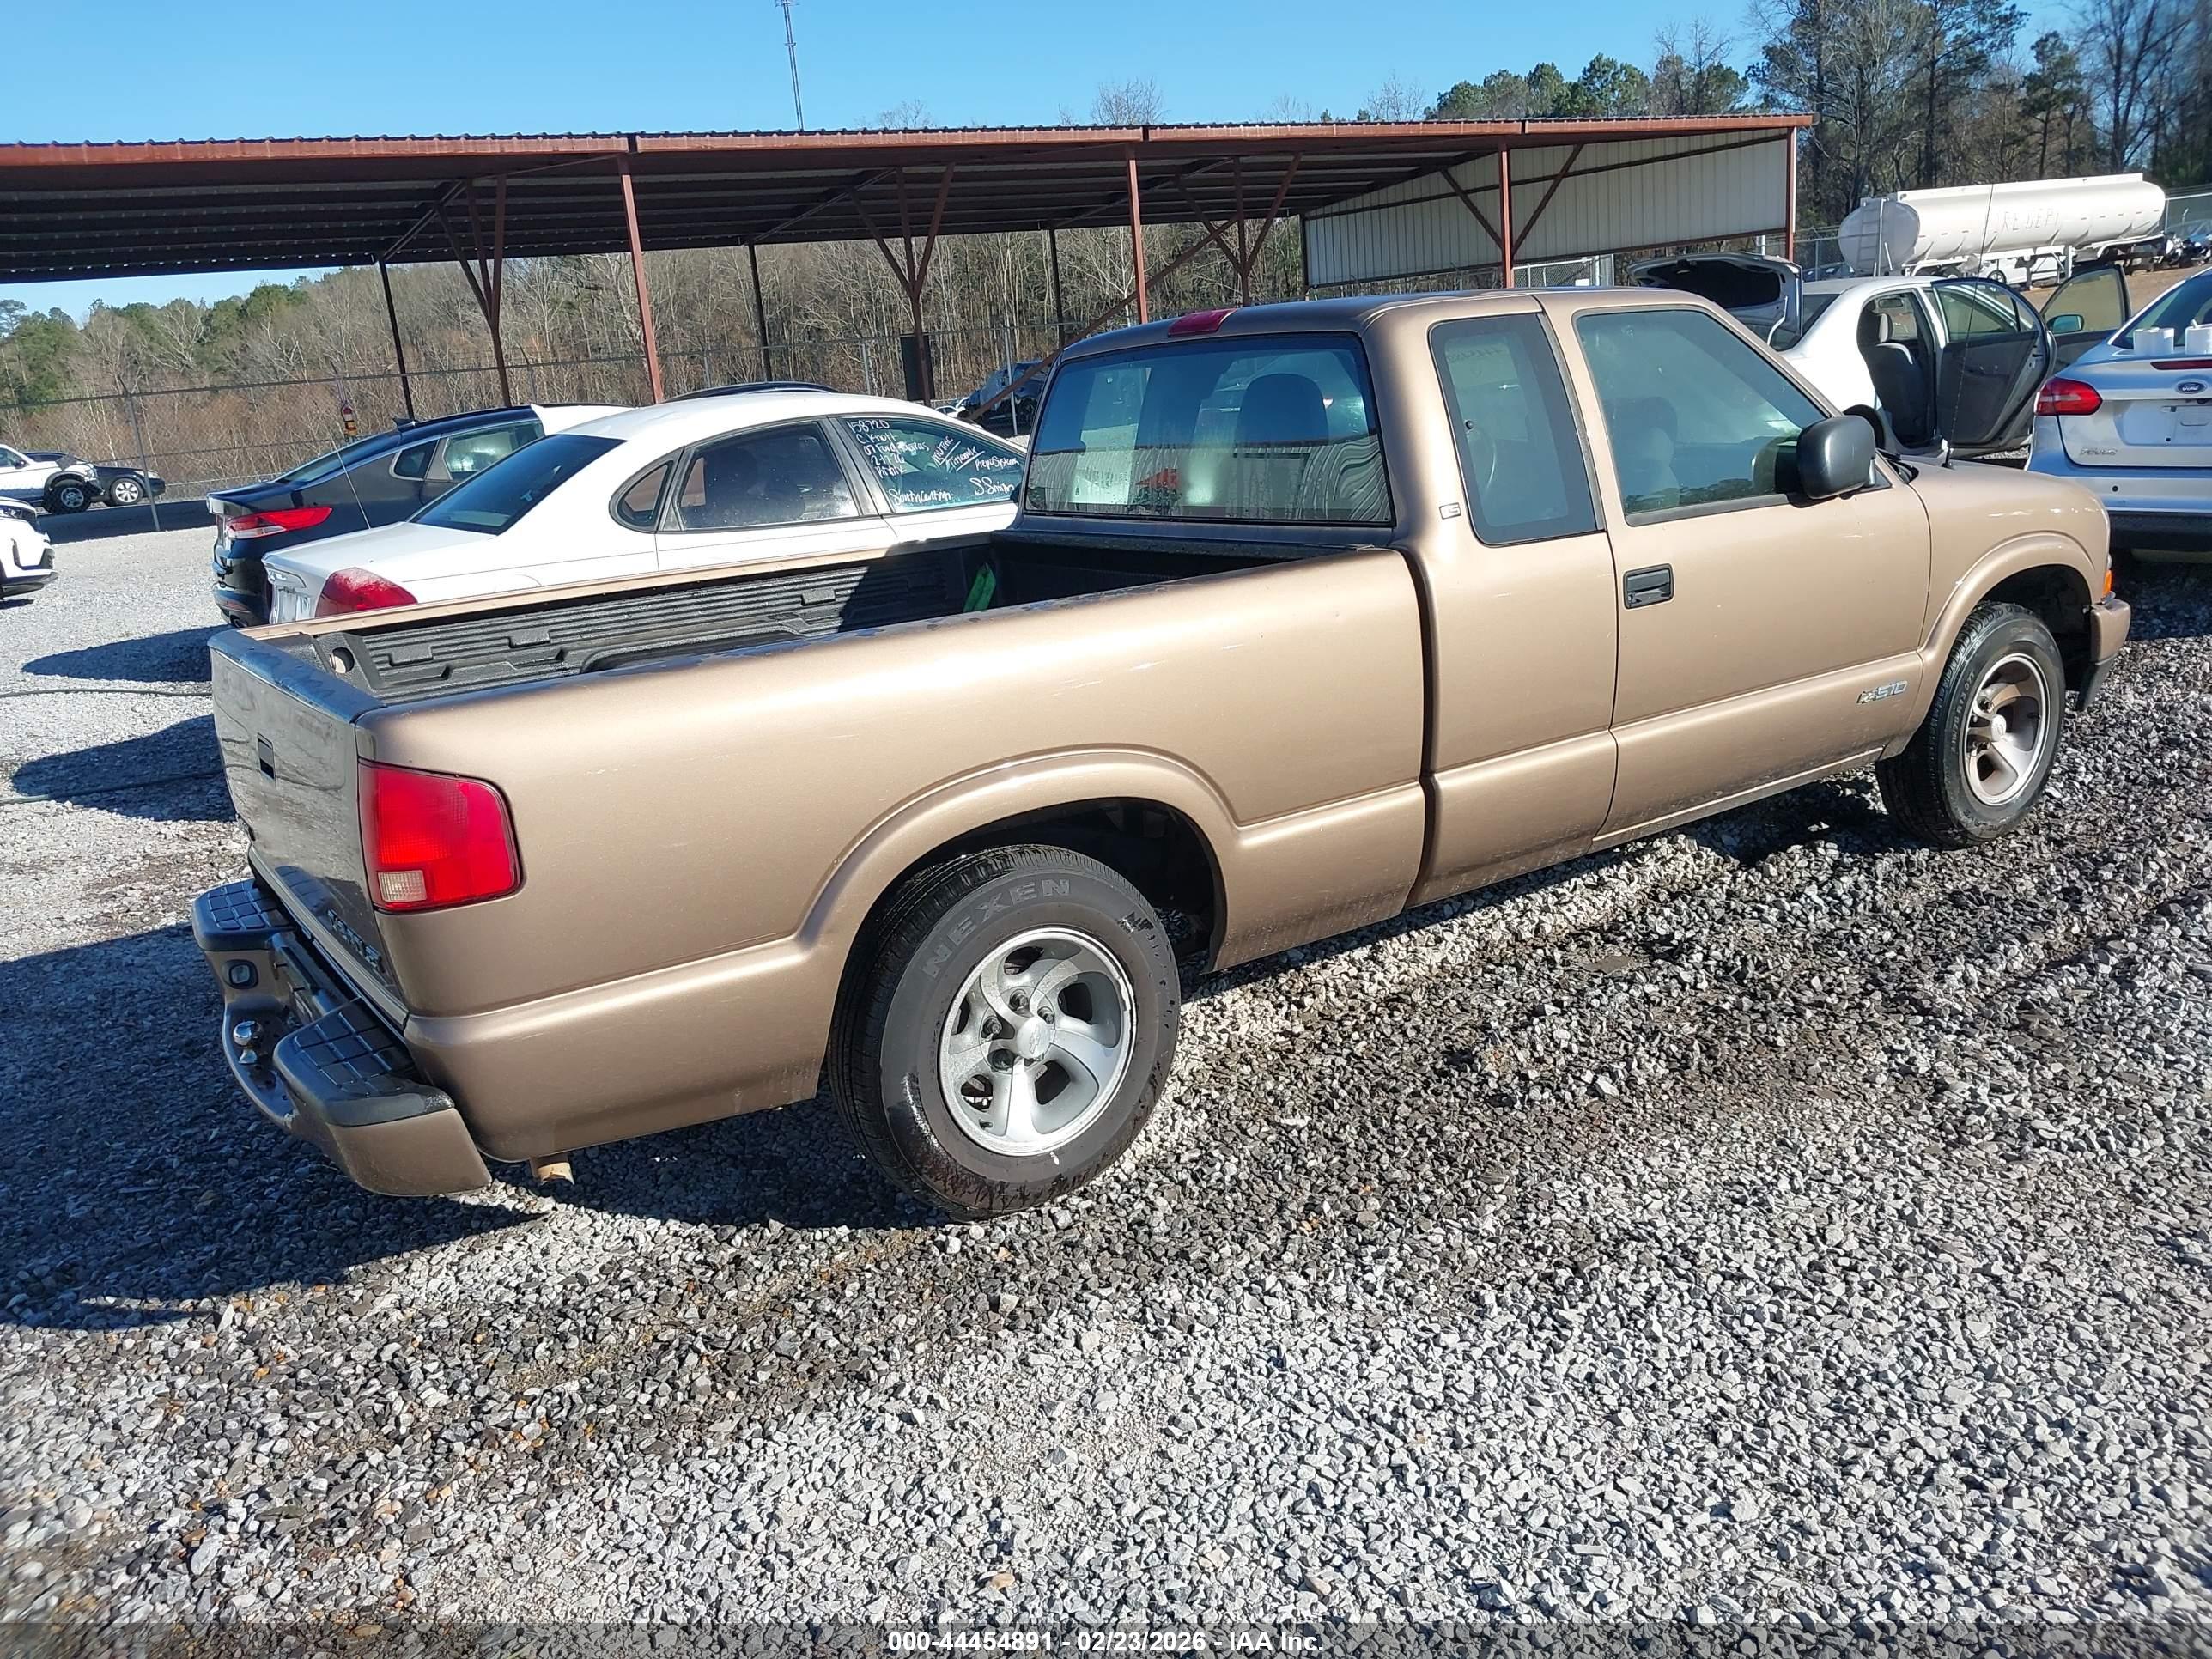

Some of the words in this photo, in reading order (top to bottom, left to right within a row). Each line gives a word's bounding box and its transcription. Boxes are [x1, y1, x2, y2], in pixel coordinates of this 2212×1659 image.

[847, 419, 890, 433] 158720
[1877, 680, 1908, 700] S10
[921, 878, 1071, 979] NEXEN
